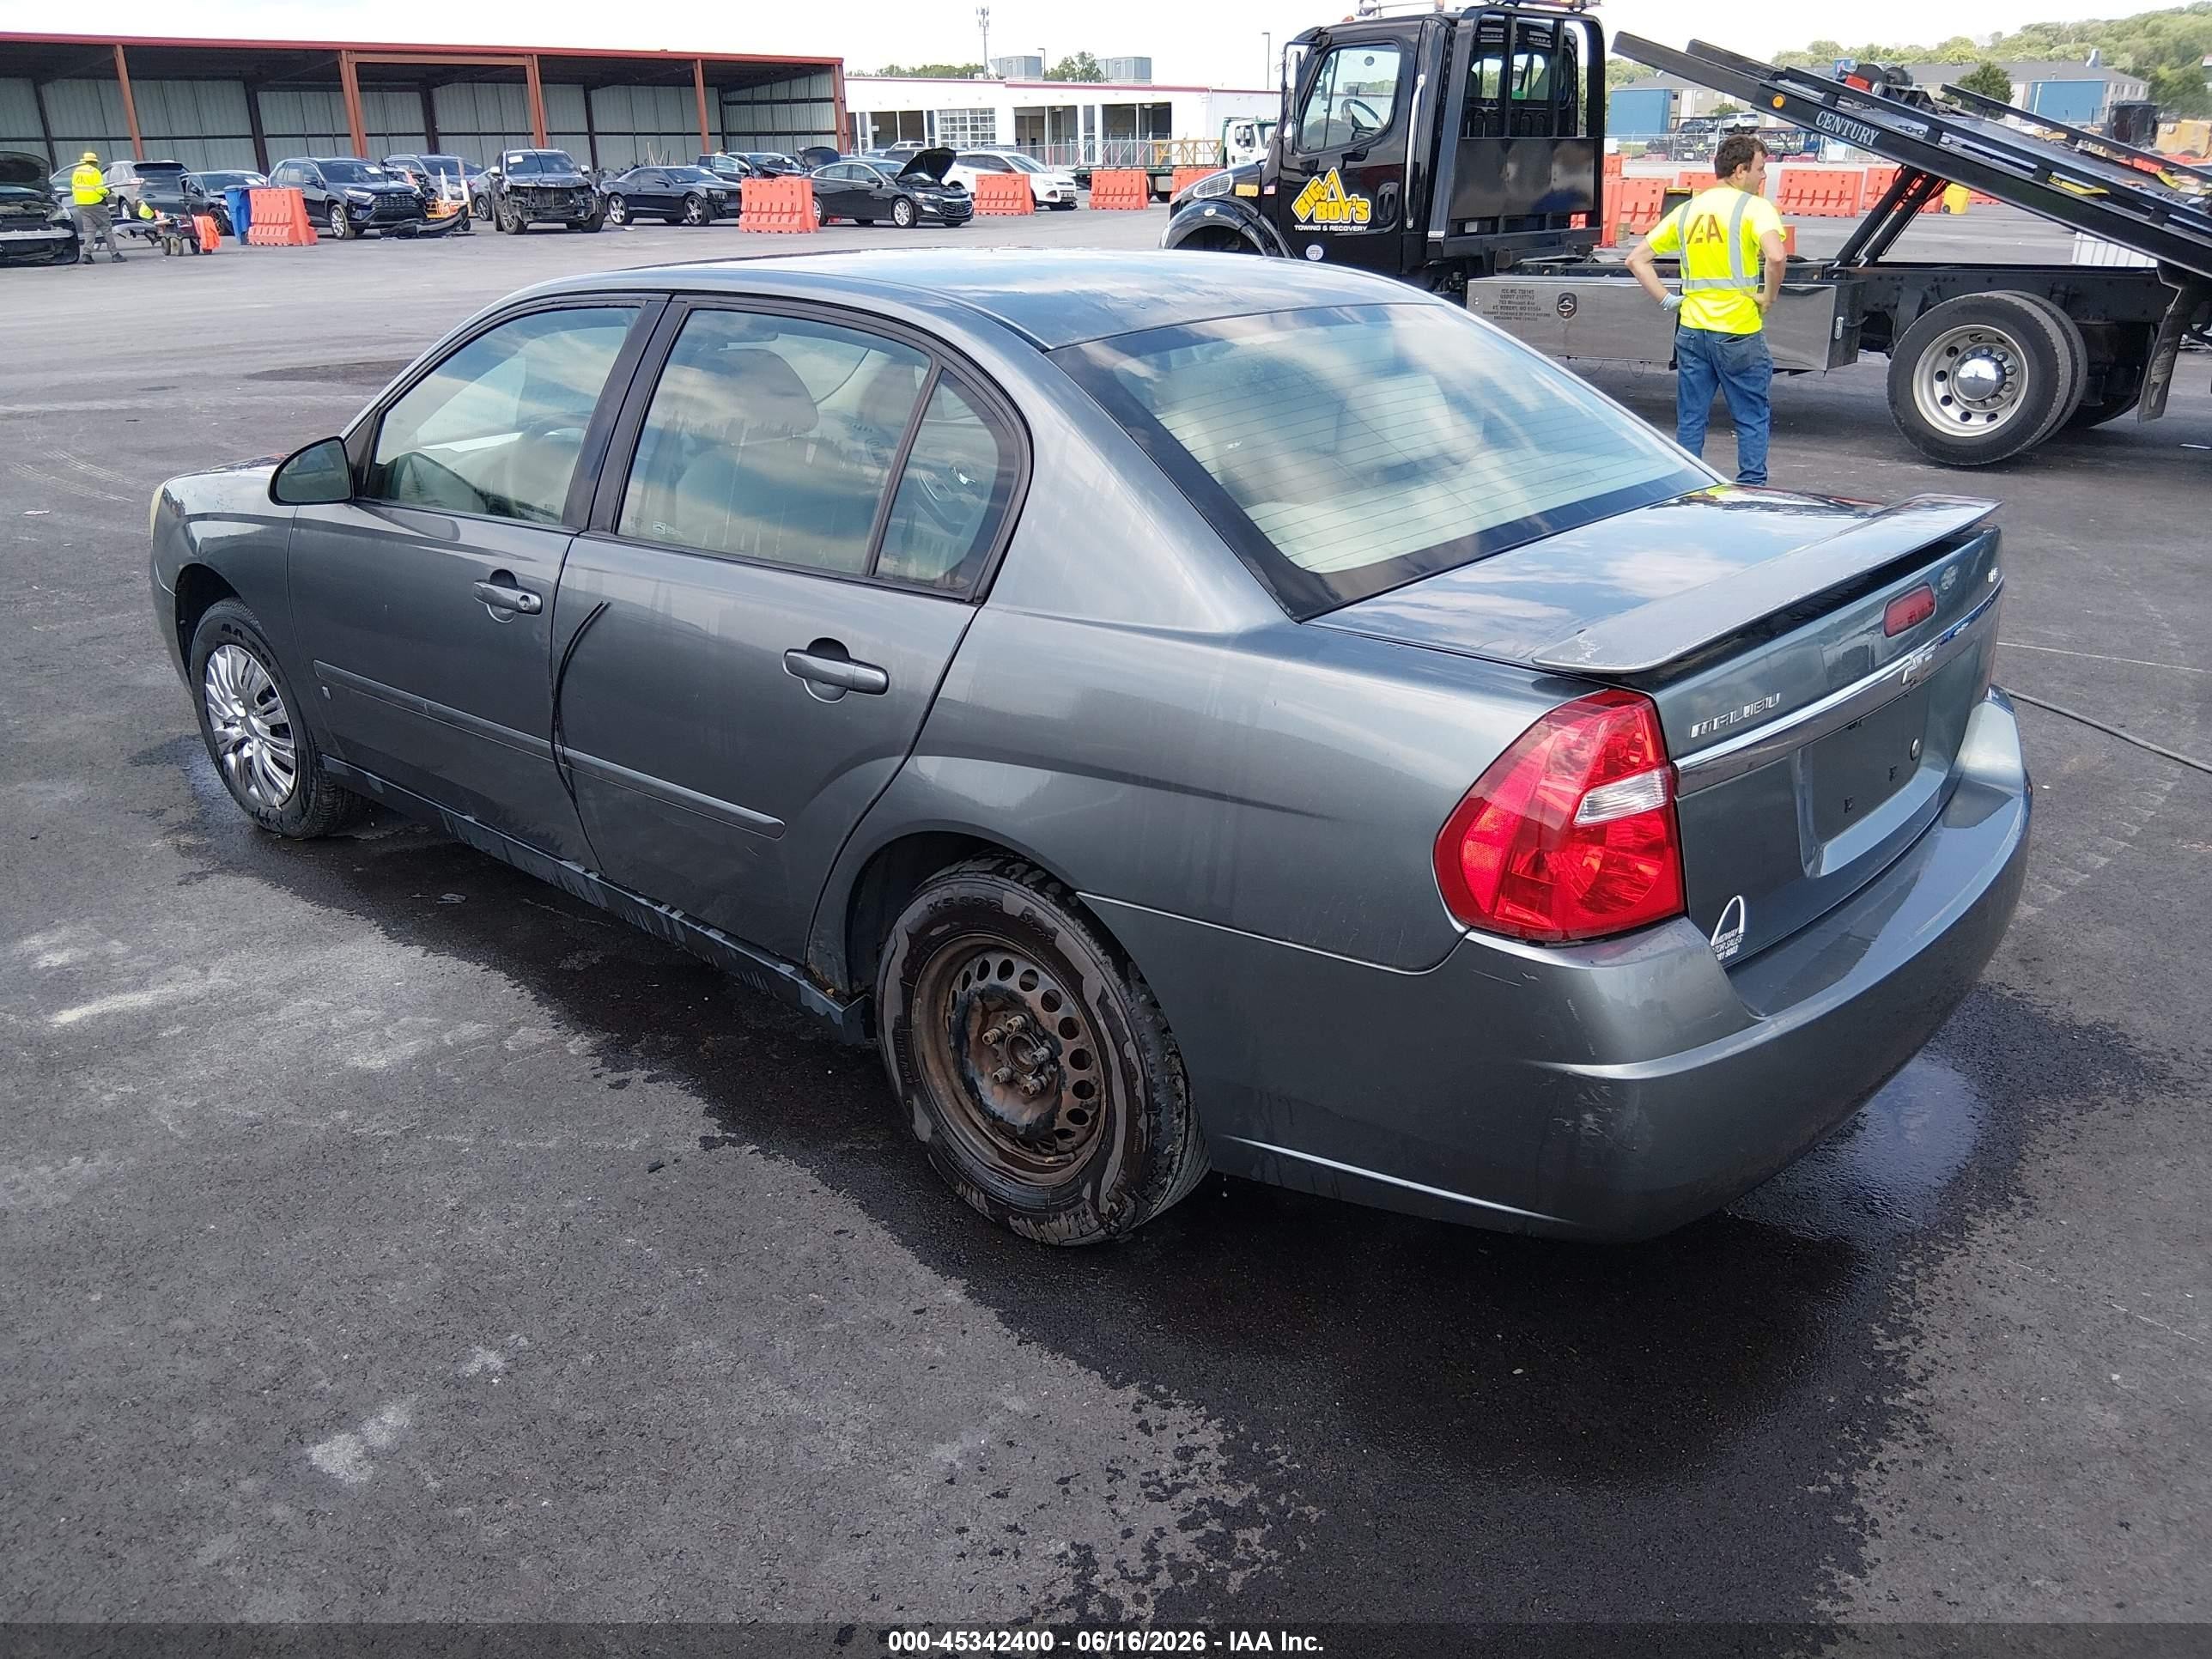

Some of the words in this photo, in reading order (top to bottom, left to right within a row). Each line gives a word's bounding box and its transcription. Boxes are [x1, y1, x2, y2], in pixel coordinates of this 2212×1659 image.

[1815, 110, 1881, 147] CENTURY
[1292, 177, 1325, 222] BIG
[1314, 195, 1370, 223] BOY'S
[1690, 692, 1781, 738] MALIBU
